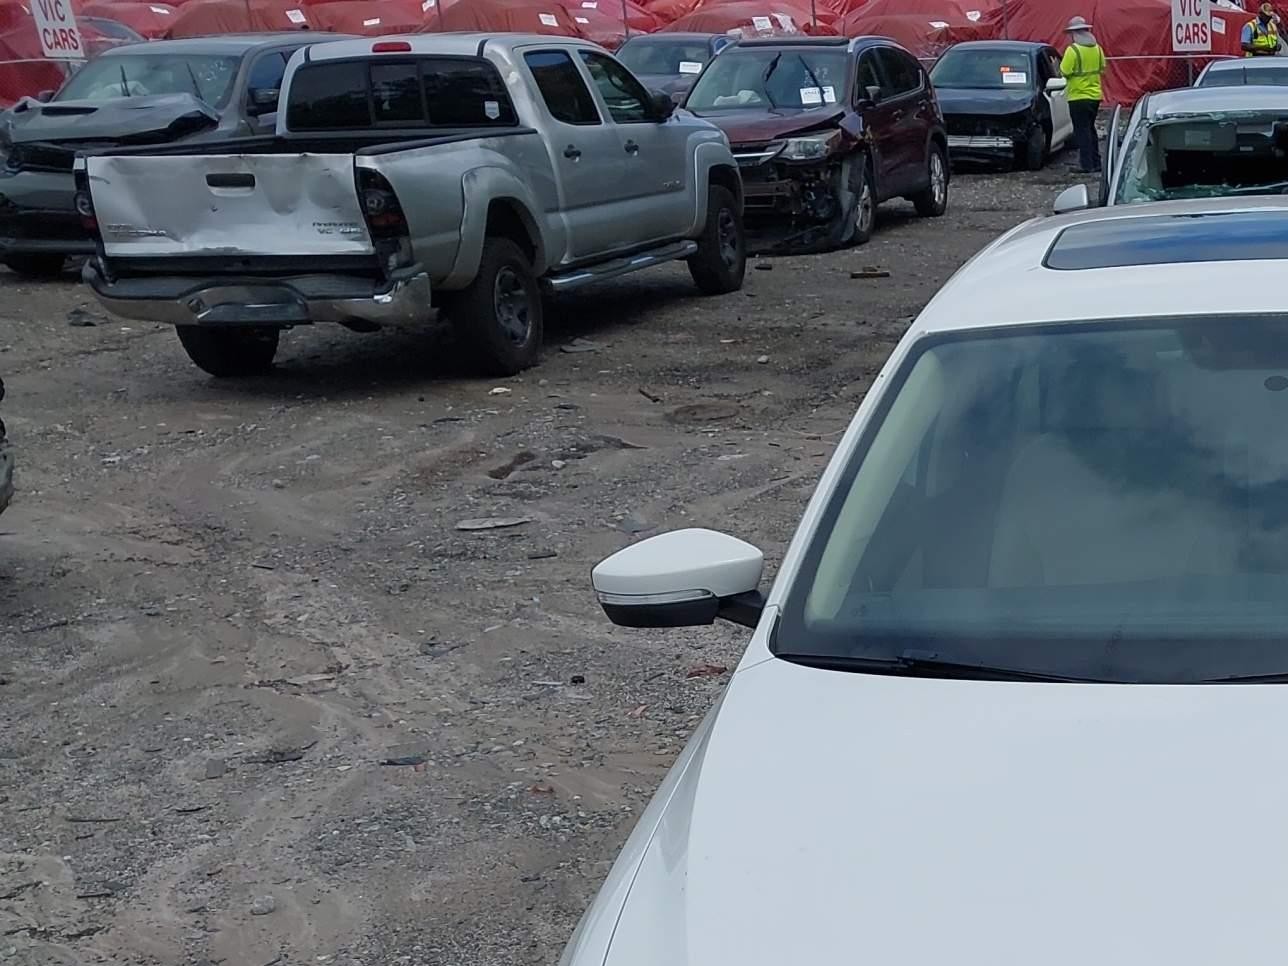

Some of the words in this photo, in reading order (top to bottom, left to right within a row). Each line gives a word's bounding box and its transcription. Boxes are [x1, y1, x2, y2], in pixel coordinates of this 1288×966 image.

[37, 0, 66, 22] VIC
[1180, 0, 1202, 17] VIC
[42, 27, 79, 50] CARS
[1175, 22, 1208, 45] CARS
